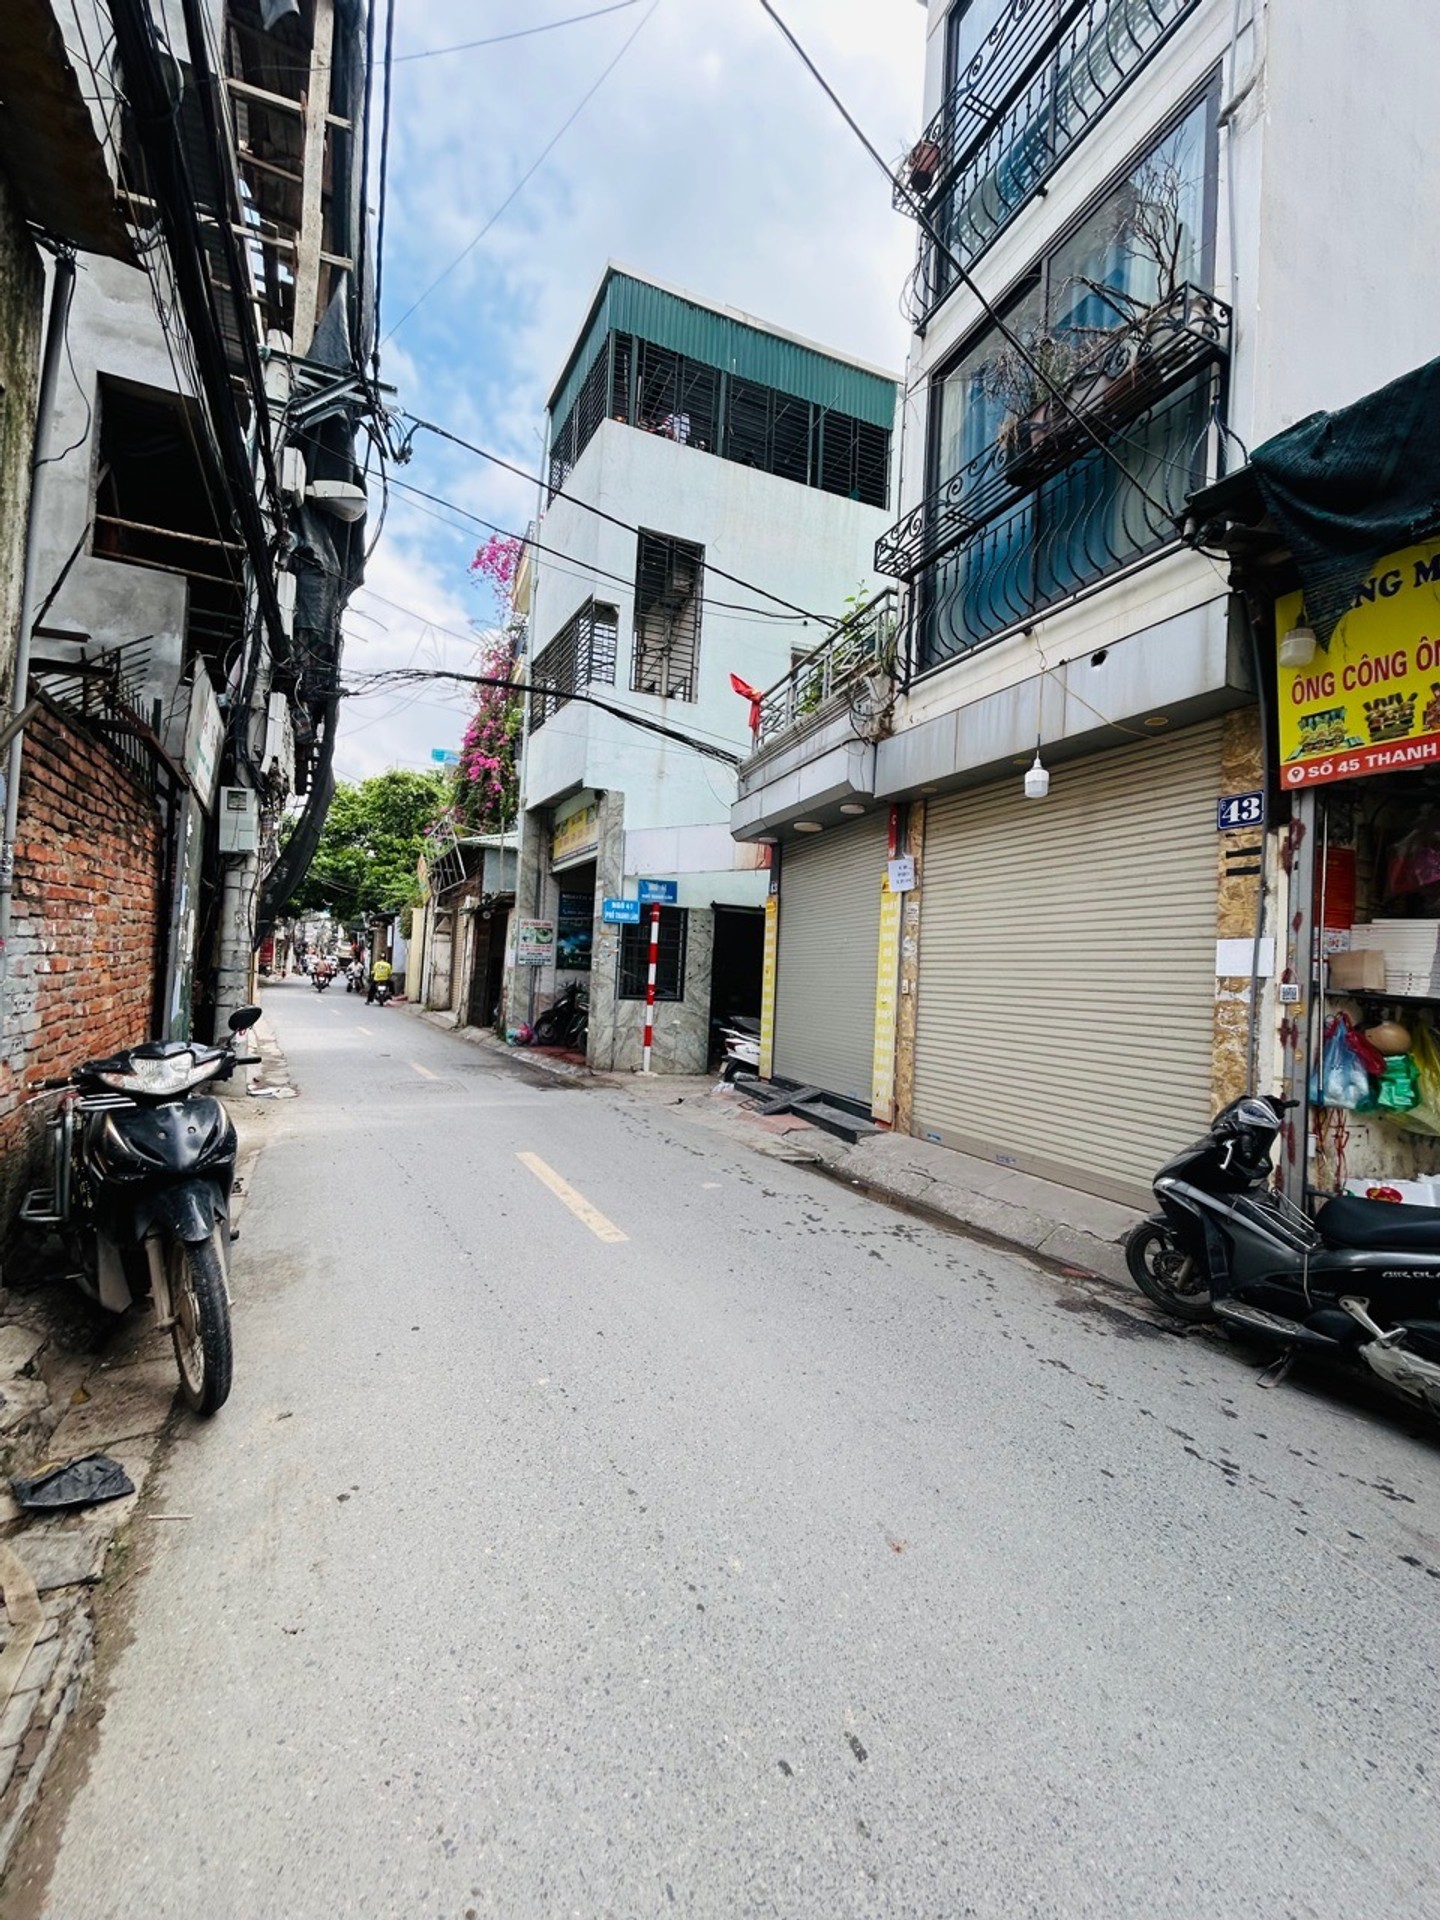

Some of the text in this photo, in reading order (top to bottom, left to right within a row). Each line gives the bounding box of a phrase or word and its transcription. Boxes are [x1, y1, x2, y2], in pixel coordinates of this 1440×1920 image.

[1352, 569, 1403, 609] NG
[1291, 671, 1336, 706] ÔNG
[1342, 650, 1408, 692] CÔNG
[1307, 742, 1438, 778] SỐ 45 THANH
[1221, 797, 1260, 823] 43
